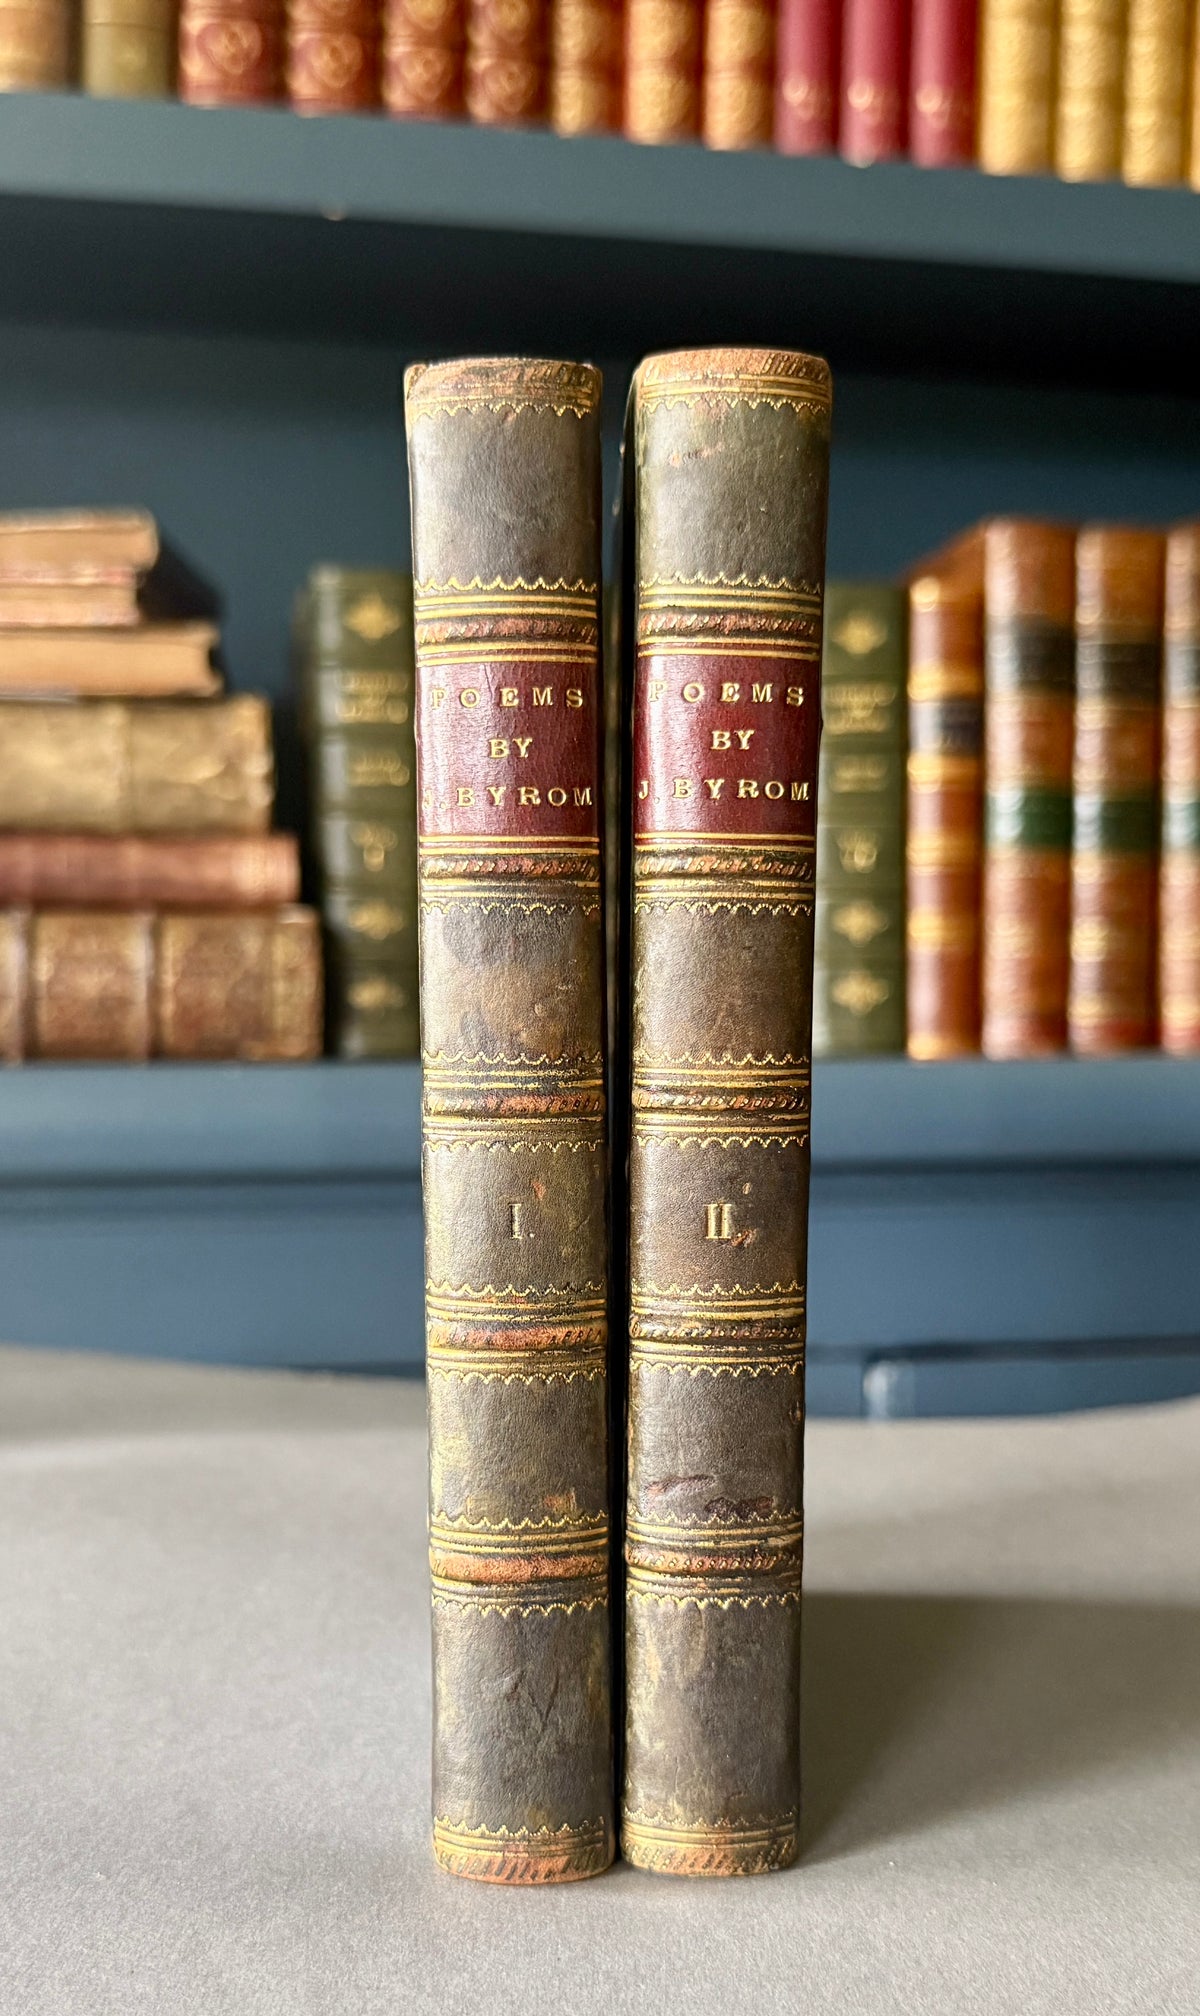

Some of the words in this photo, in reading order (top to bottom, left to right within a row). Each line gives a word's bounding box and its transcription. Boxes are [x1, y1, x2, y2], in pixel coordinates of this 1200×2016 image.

[430, 686, 584, 710] POEMS
[648, 681, 804, 708] POEMS
[489, 738, 533, 759] BY
[711, 730, 755, 750] BY
[456, 787, 592, 808] BYROM
[673, 779, 809, 802] BYROM
[509, 1203, 535, 1240] I.
